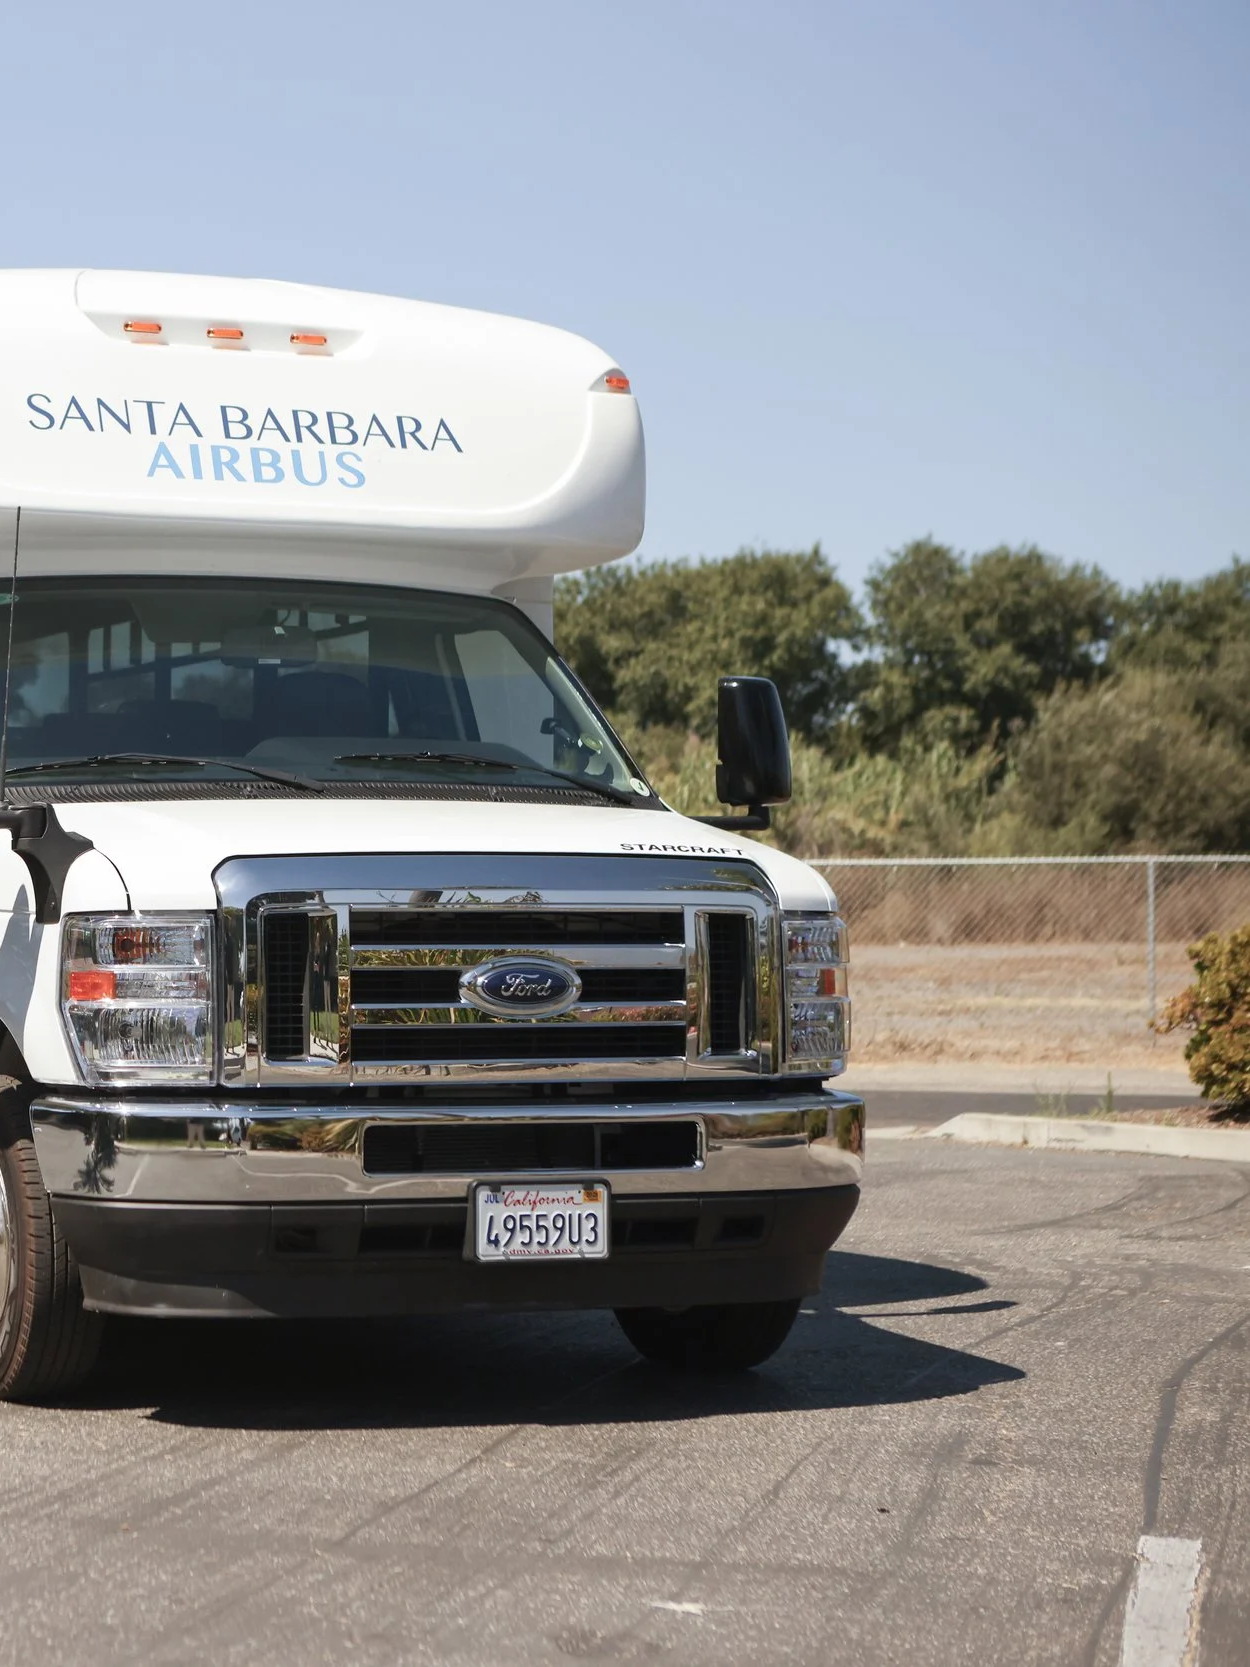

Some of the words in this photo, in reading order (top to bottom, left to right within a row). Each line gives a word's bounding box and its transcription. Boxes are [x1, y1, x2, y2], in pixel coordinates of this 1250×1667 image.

[26, 393, 203, 439] SANTA
[220, 405, 464, 453] BARBARA
[147, 441, 366, 489] AIRBUS
[620, 843, 743, 855] STARCRAFT
[501, 972, 552, 997] Ford
[485, 1193, 500, 1204] JUL
[503, 1190, 583, 1211] California
[487, 1212, 599, 1248] 49559U3
